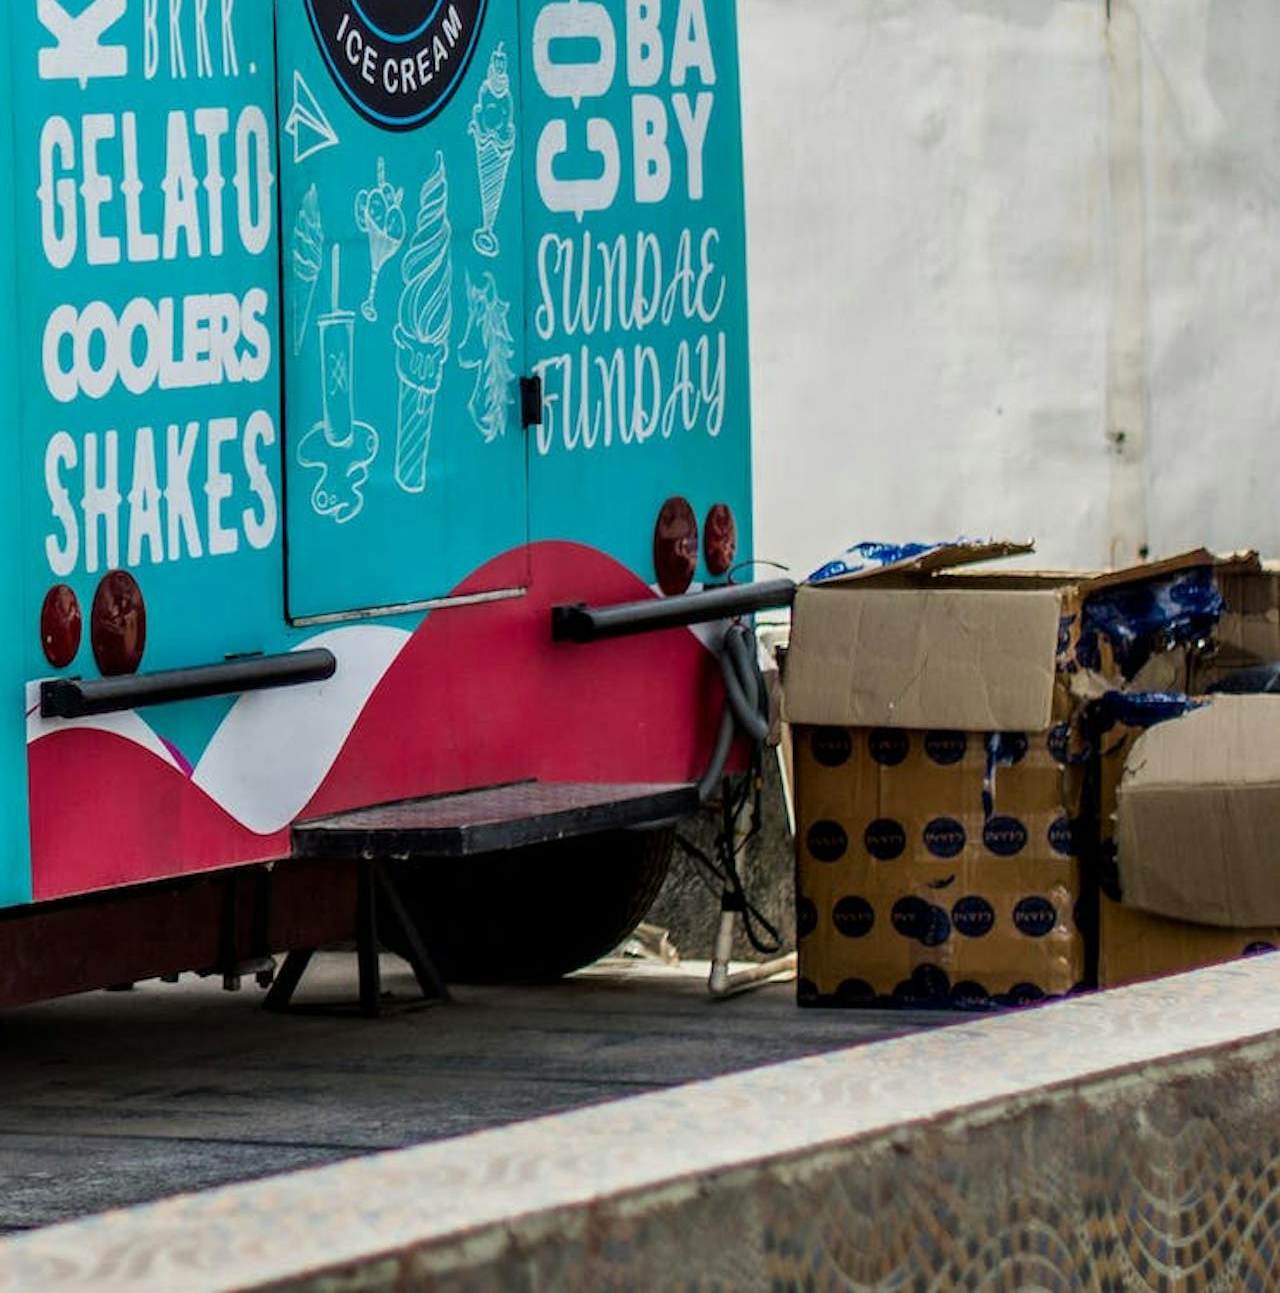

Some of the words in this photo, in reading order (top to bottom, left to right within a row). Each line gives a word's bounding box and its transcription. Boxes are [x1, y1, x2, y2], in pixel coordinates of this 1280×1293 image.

[336, 13, 375, 85] ICE
[383, 4, 463, 95] CREAM
[37, 106, 273, 268] GELATO
[632, 92, 713, 202] BY
[534, 227, 726, 341] SUNDAE
[43, 288, 270, 402] COOLERS
[532, 331, 726, 456] FUNDAY
[45, 410, 277, 576] SHAKES
